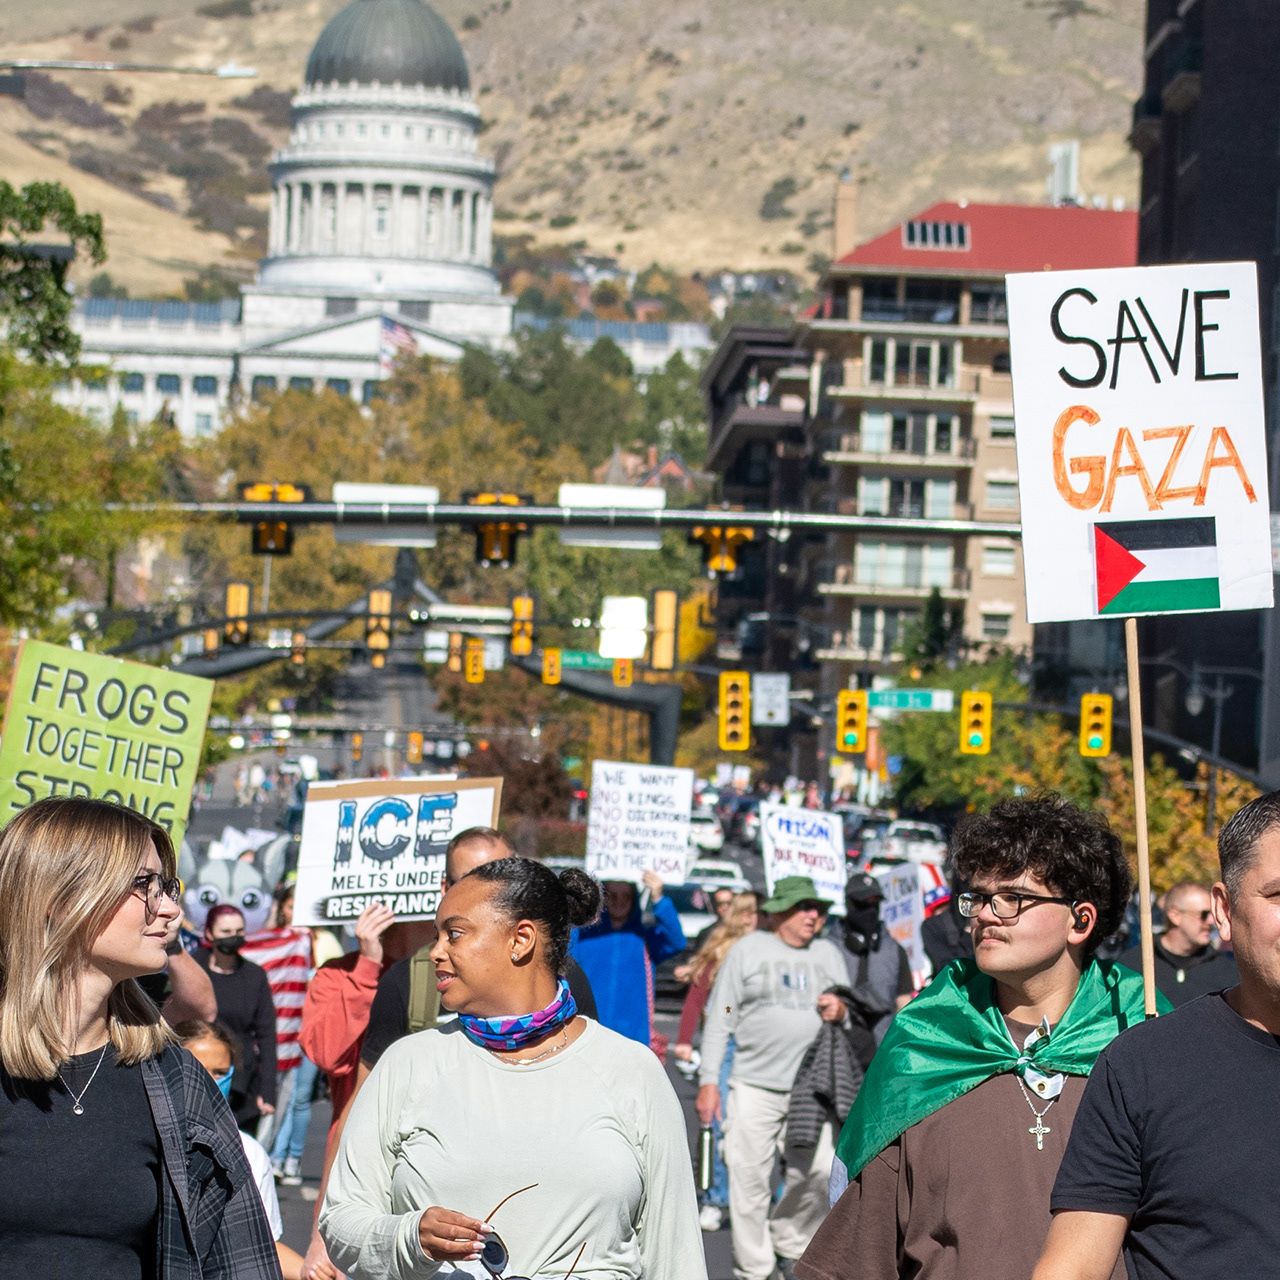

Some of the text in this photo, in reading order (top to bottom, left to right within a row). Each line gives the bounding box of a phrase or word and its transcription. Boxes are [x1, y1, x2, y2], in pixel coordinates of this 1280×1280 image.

[1049, 287, 1239, 390] SAVE
[1052, 404, 1259, 514] GAZA
[29, 661, 191, 736] FROGS
[23, 715, 185, 788] TOGETHER
[603, 770, 679, 787] WE WANT
[627, 792, 675, 808] KINGS
[333, 792, 457, 866] ICE
[627, 809, 688, 824] DICTATORS
[595, 852, 682, 874] IN THE USA
[331, 873, 389, 890] MELTS
[326, 891, 443, 918] RESITANC
